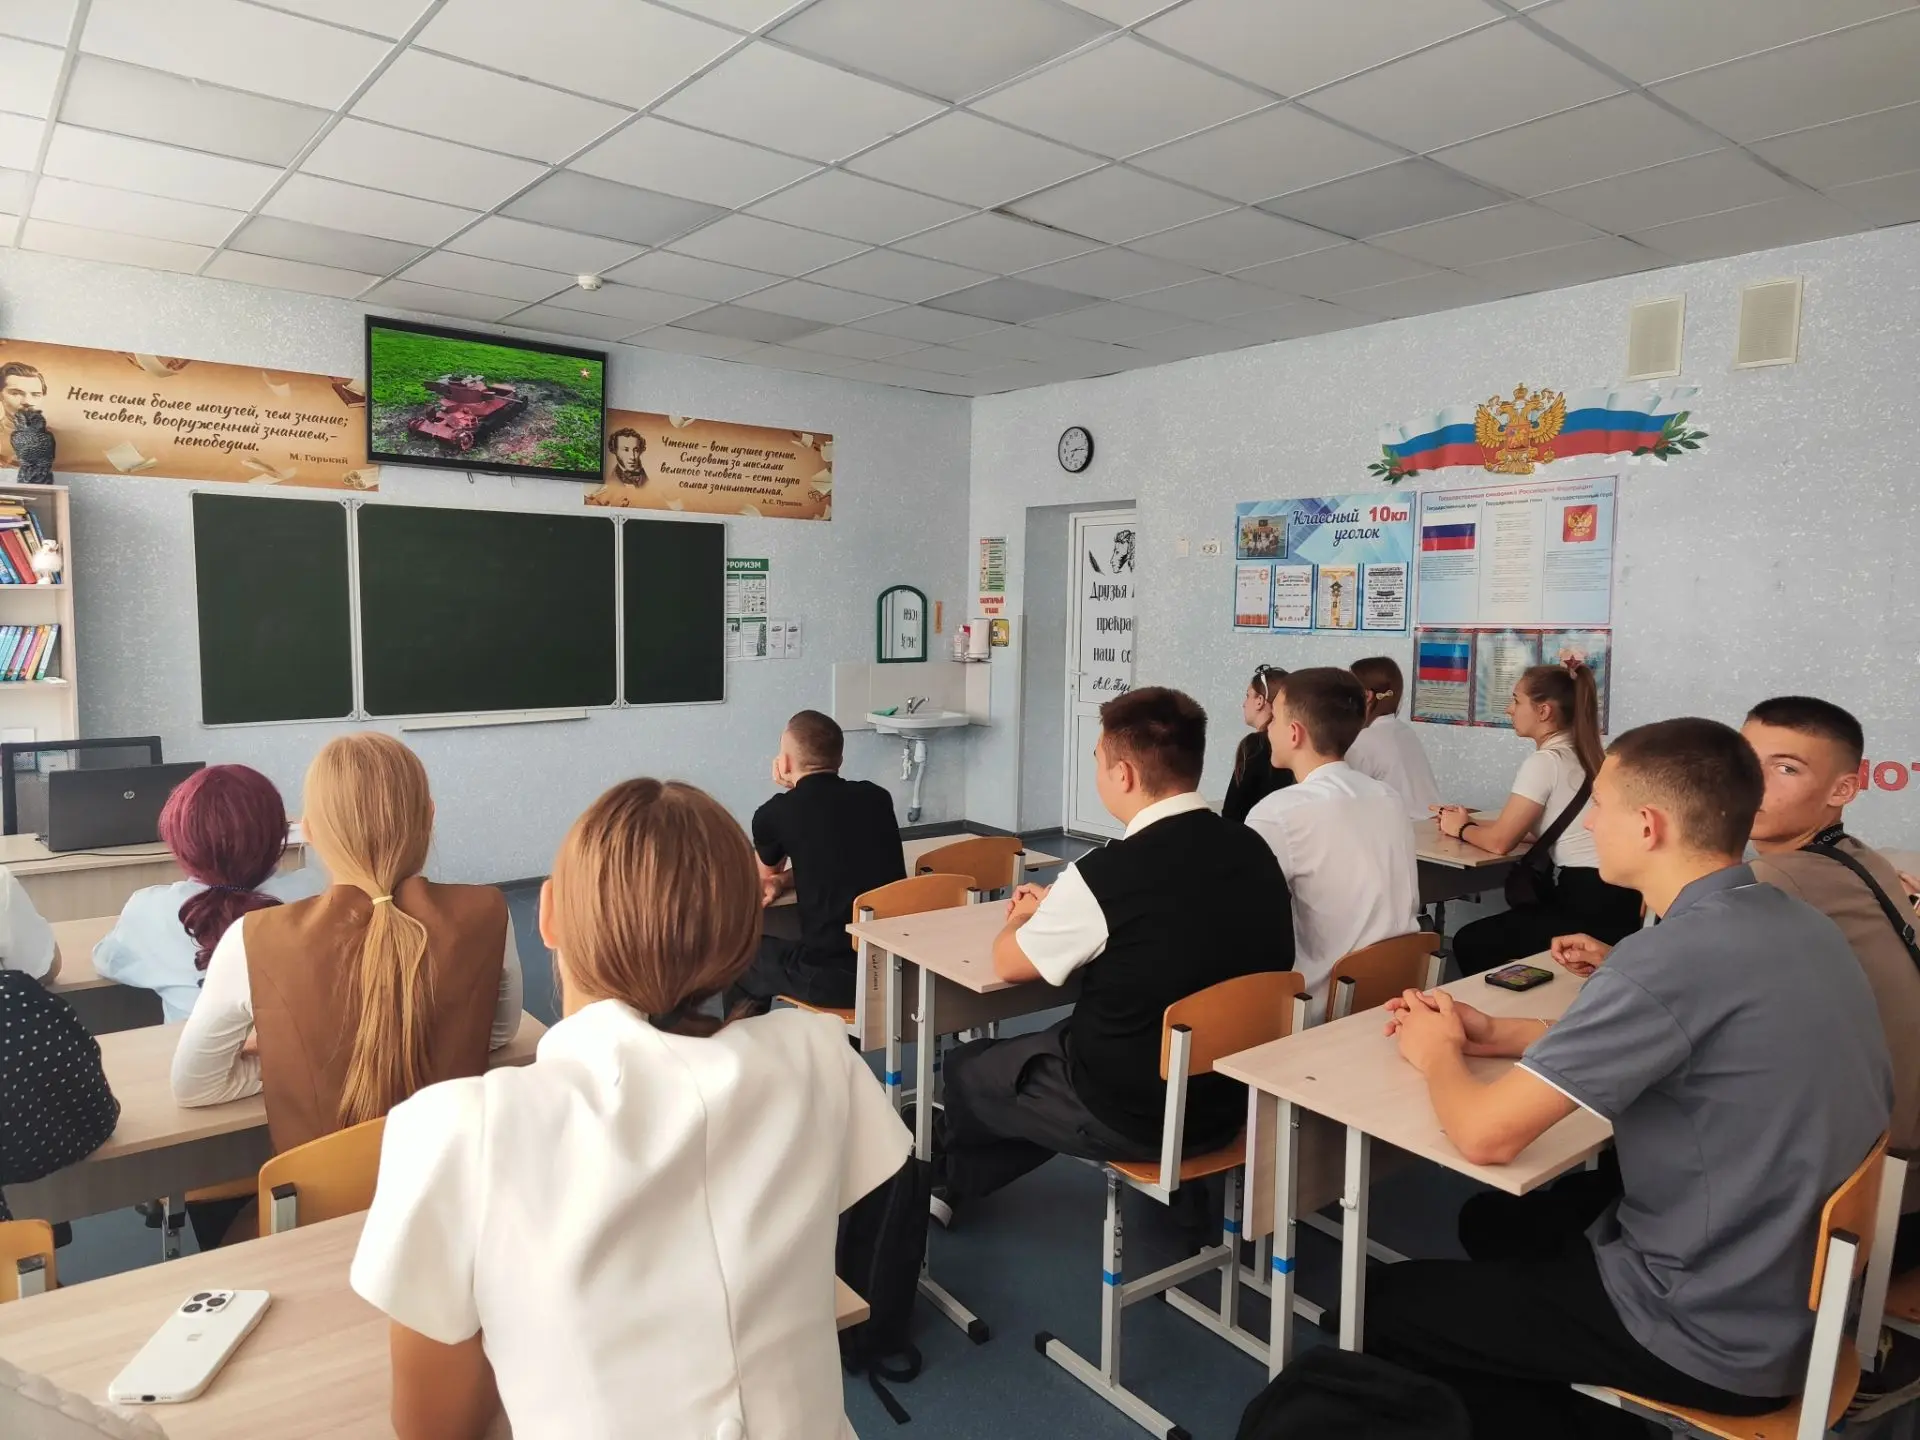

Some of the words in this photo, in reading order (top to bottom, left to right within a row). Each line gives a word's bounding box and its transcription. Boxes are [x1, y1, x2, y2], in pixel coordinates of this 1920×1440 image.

[67, 386, 104, 402] Нет
[109, 394, 147, 406] силы
[151, 393, 192, 410] более
[196, 404, 259, 420] могучей,
[265, 409, 291, 420] чем
[293, 412, 349, 427] знание;
[83, 408, 147, 426] человек,
[153, 411, 260, 433] вооруженный
[174, 434, 260, 454] непобедим.
[661, 436, 699, 450] Чтение
[710, 441, 729, 453] вот
[731, 446, 763, 461] лучшее
[765, 450, 797, 462] учение.
[289, 453, 302, 463] М.
[304, 454, 348, 465] Горький
[680, 452, 729, 468] Следовать
[731, 460, 741, 470] за
[742, 460, 784, 471] мыслями
[660, 462, 701, 477] великого
[704, 468, 742, 480] человека
[752, 474, 772, 483] есть
[775, 476, 801, 488] наука
[679, 481, 708, 491] самая
[709, 484, 784, 497] занимательная.
[1293, 508, 1360, 526] Классный
[1369, 506, 1408, 522] 10кл
[1333, 528, 1380, 547] уголок
[1090, 581, 1127, 601] Друзья
[1096, 616, 1133, 635] прекра
[1093, 648, 1115, 662] наш
